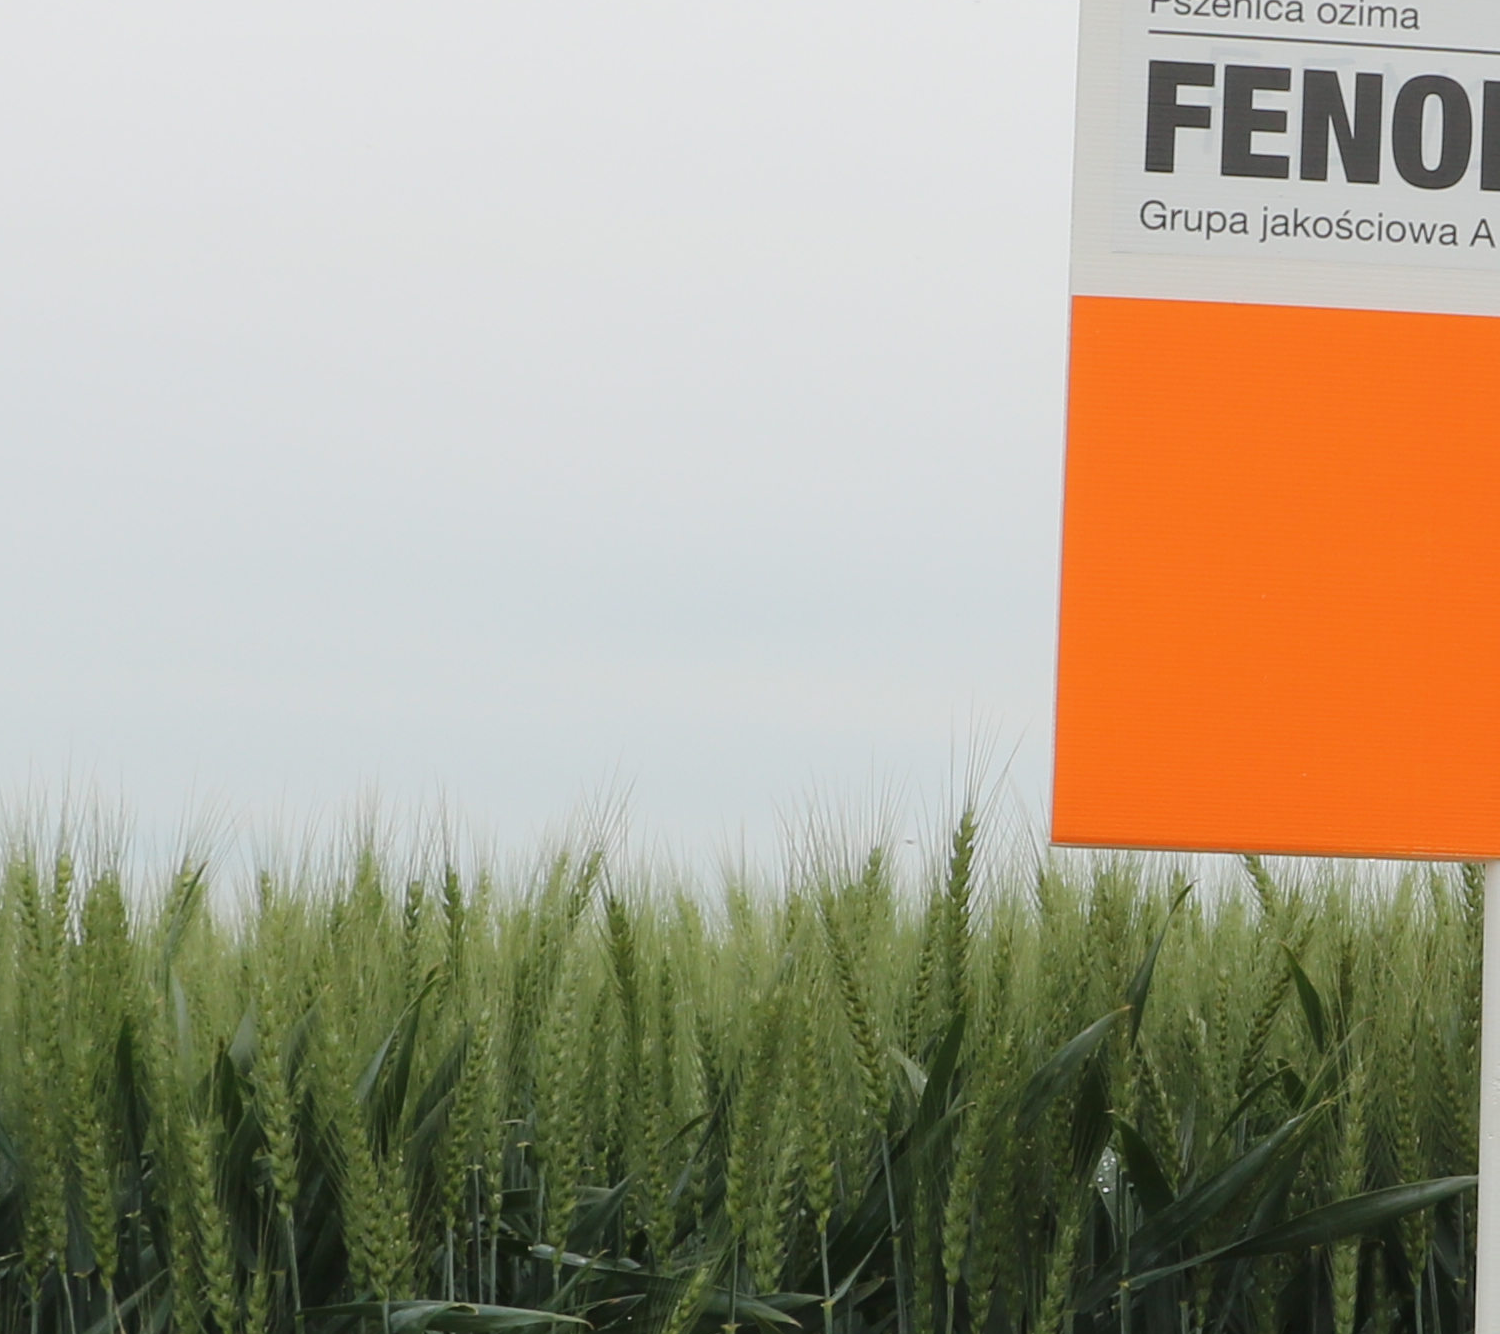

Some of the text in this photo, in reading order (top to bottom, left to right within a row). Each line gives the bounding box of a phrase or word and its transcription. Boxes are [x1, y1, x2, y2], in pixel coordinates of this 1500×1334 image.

[1316, 2, 1421, 31] ozima
[1139, 199, 1497, 249] Grupa jakościowa A
